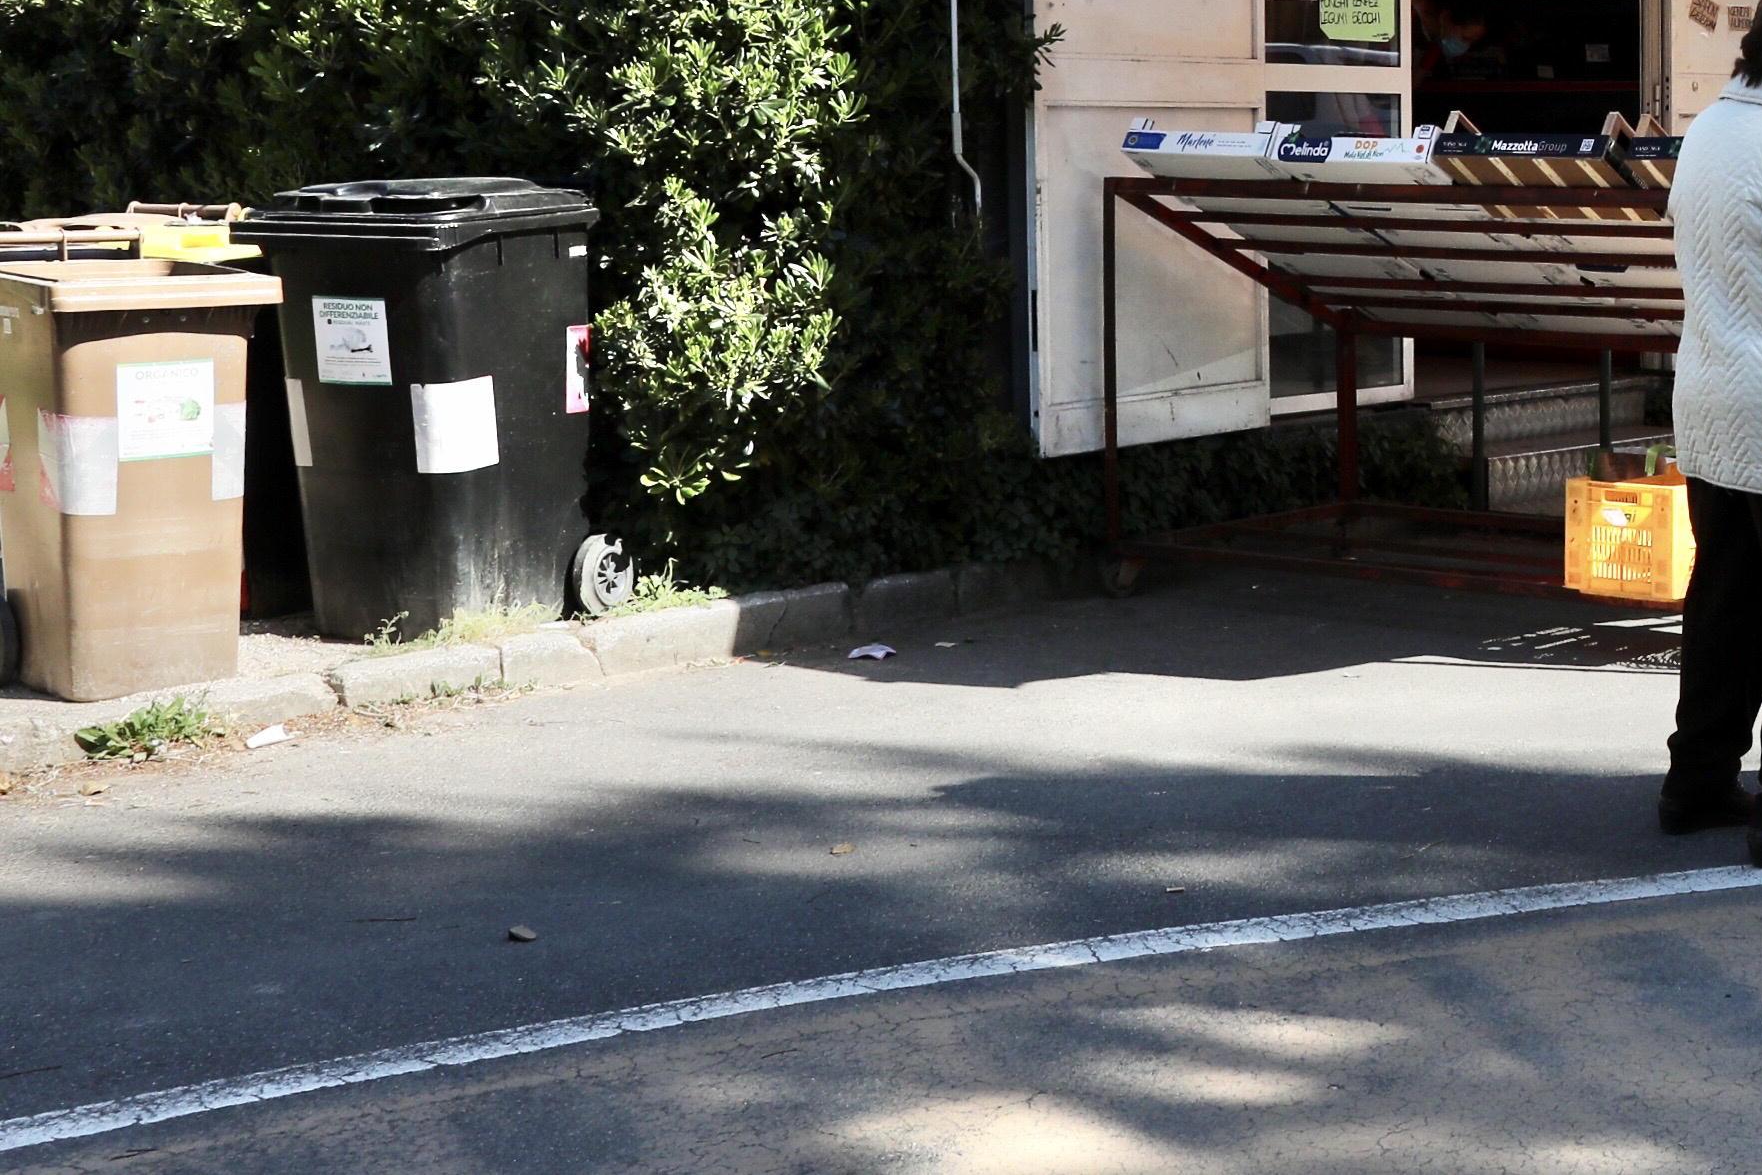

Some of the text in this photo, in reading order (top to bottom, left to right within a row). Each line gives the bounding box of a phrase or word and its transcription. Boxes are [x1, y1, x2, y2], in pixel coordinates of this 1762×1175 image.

[1280, 141, 1329, 158] Melinda
[1354, 140, 1378, 150] DOP
[323, 302, 373, 311] RESIDUO NON
[135, 368, 199, 380] ORGANICO
